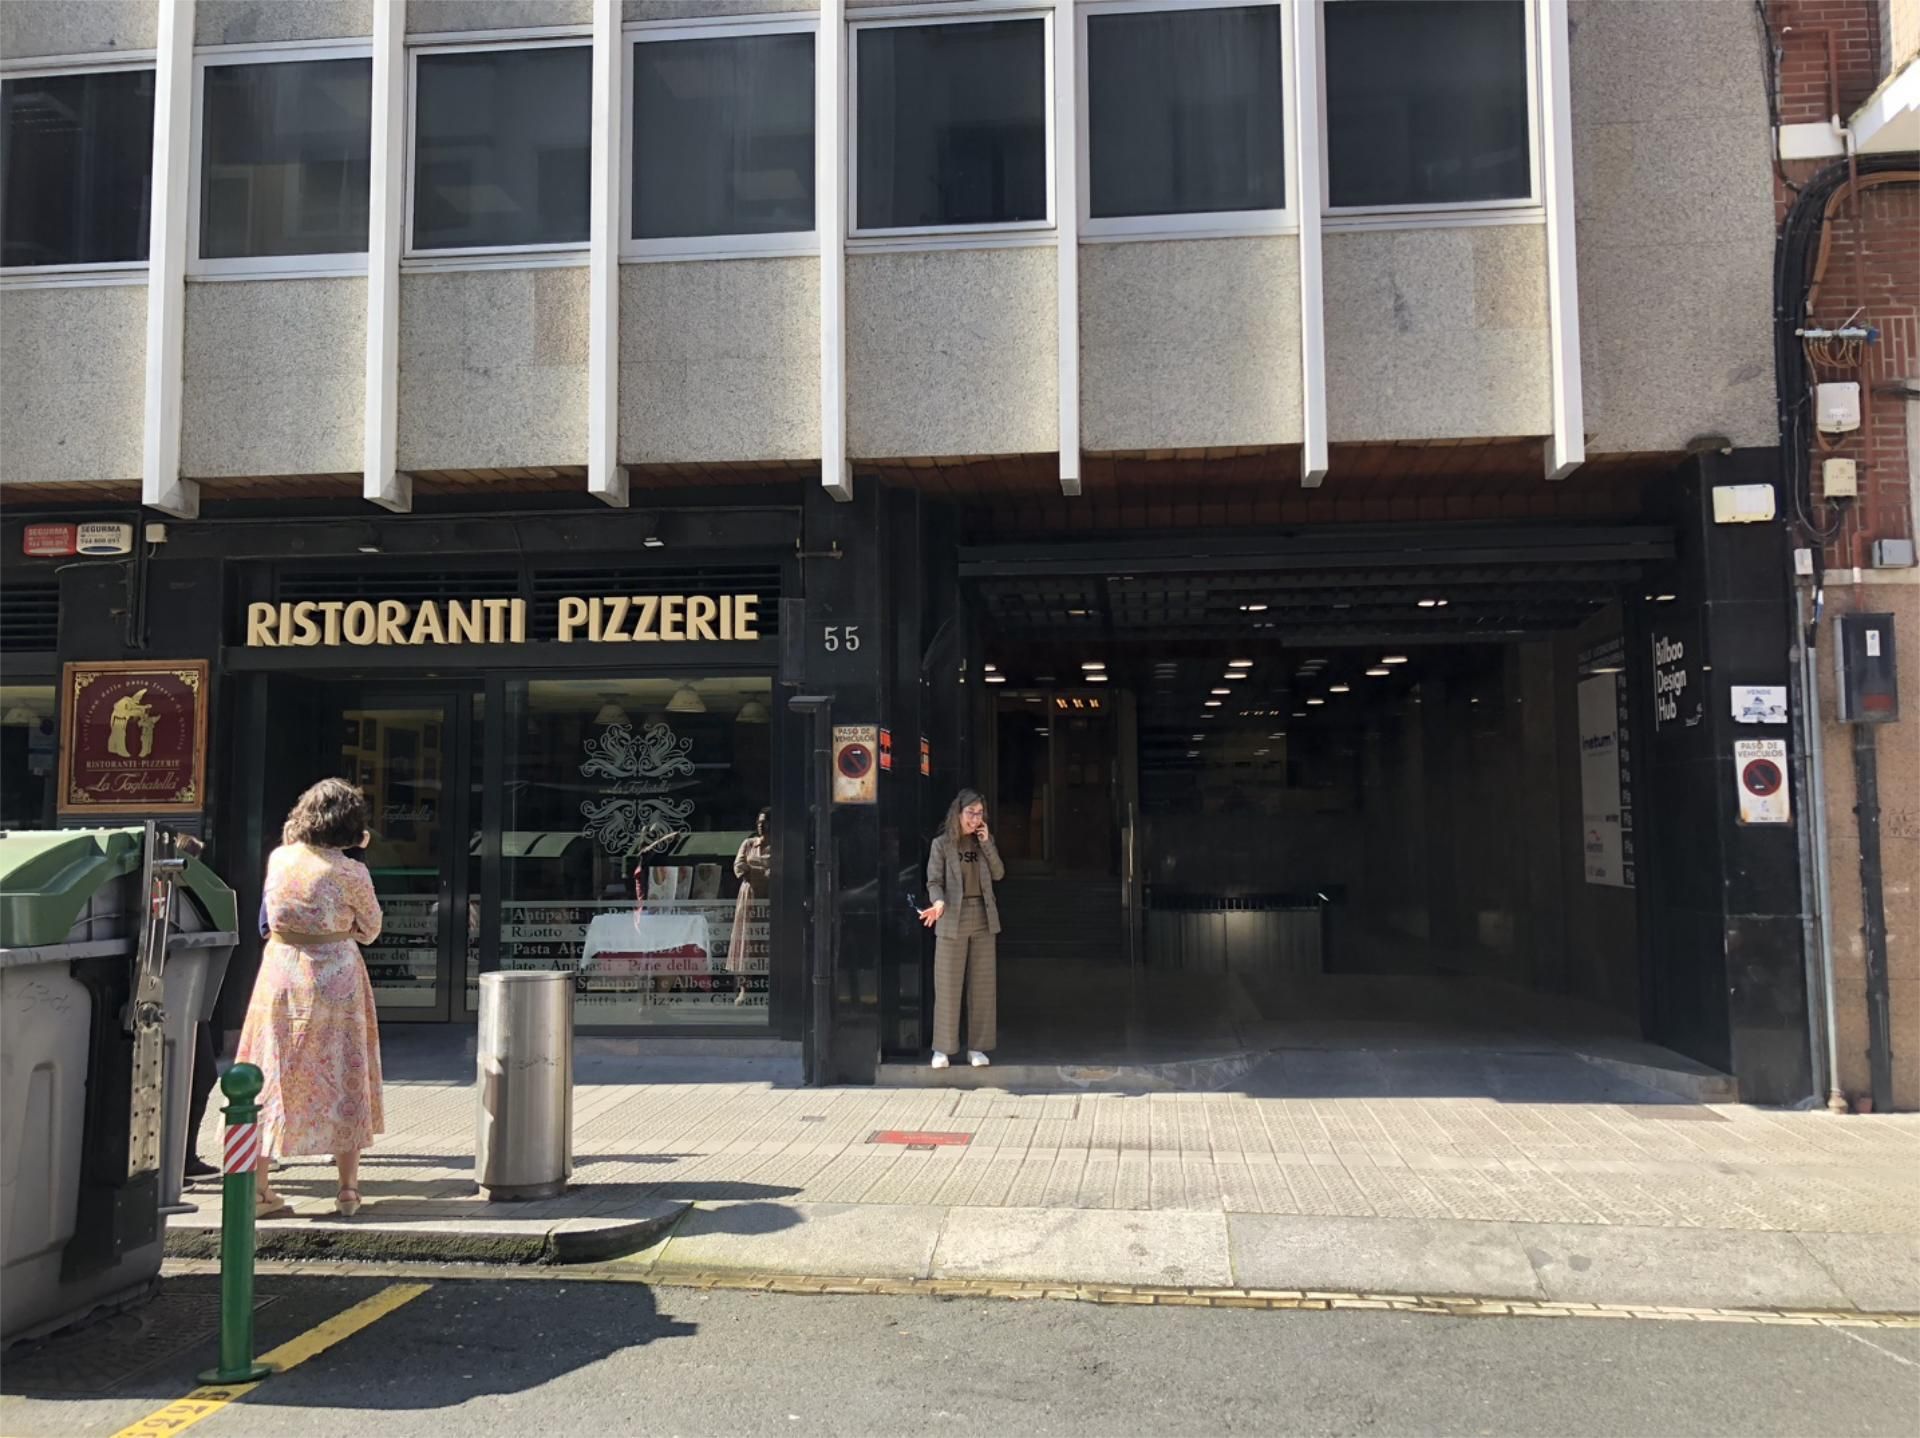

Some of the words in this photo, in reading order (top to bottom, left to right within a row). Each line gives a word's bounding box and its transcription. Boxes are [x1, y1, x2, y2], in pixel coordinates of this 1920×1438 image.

[81, 525, 121, 533] SEGURMA
[247, 597, 526, 647] RISTORANTI
[557, 594, 758, 643] PIZZERIE
[824, 626, 860, 651] 55
[1655, 635, 1684, 666] Bilbao
[1656, 666, 1687, 696] Design
[1657, 697, 1678, 722] Hub
[838, 727, 859, 735] PASO
[835, 734, 875, 743] VEHICULOS
[1741, 742, 1763, 750] PASO
[1737, 750, 1783, 758] VEHICULOS
[512, 908, 580, 922] Antipasti
[513, 943, 550, 955] Pasta
[673, 975, 720, 989] Albese
